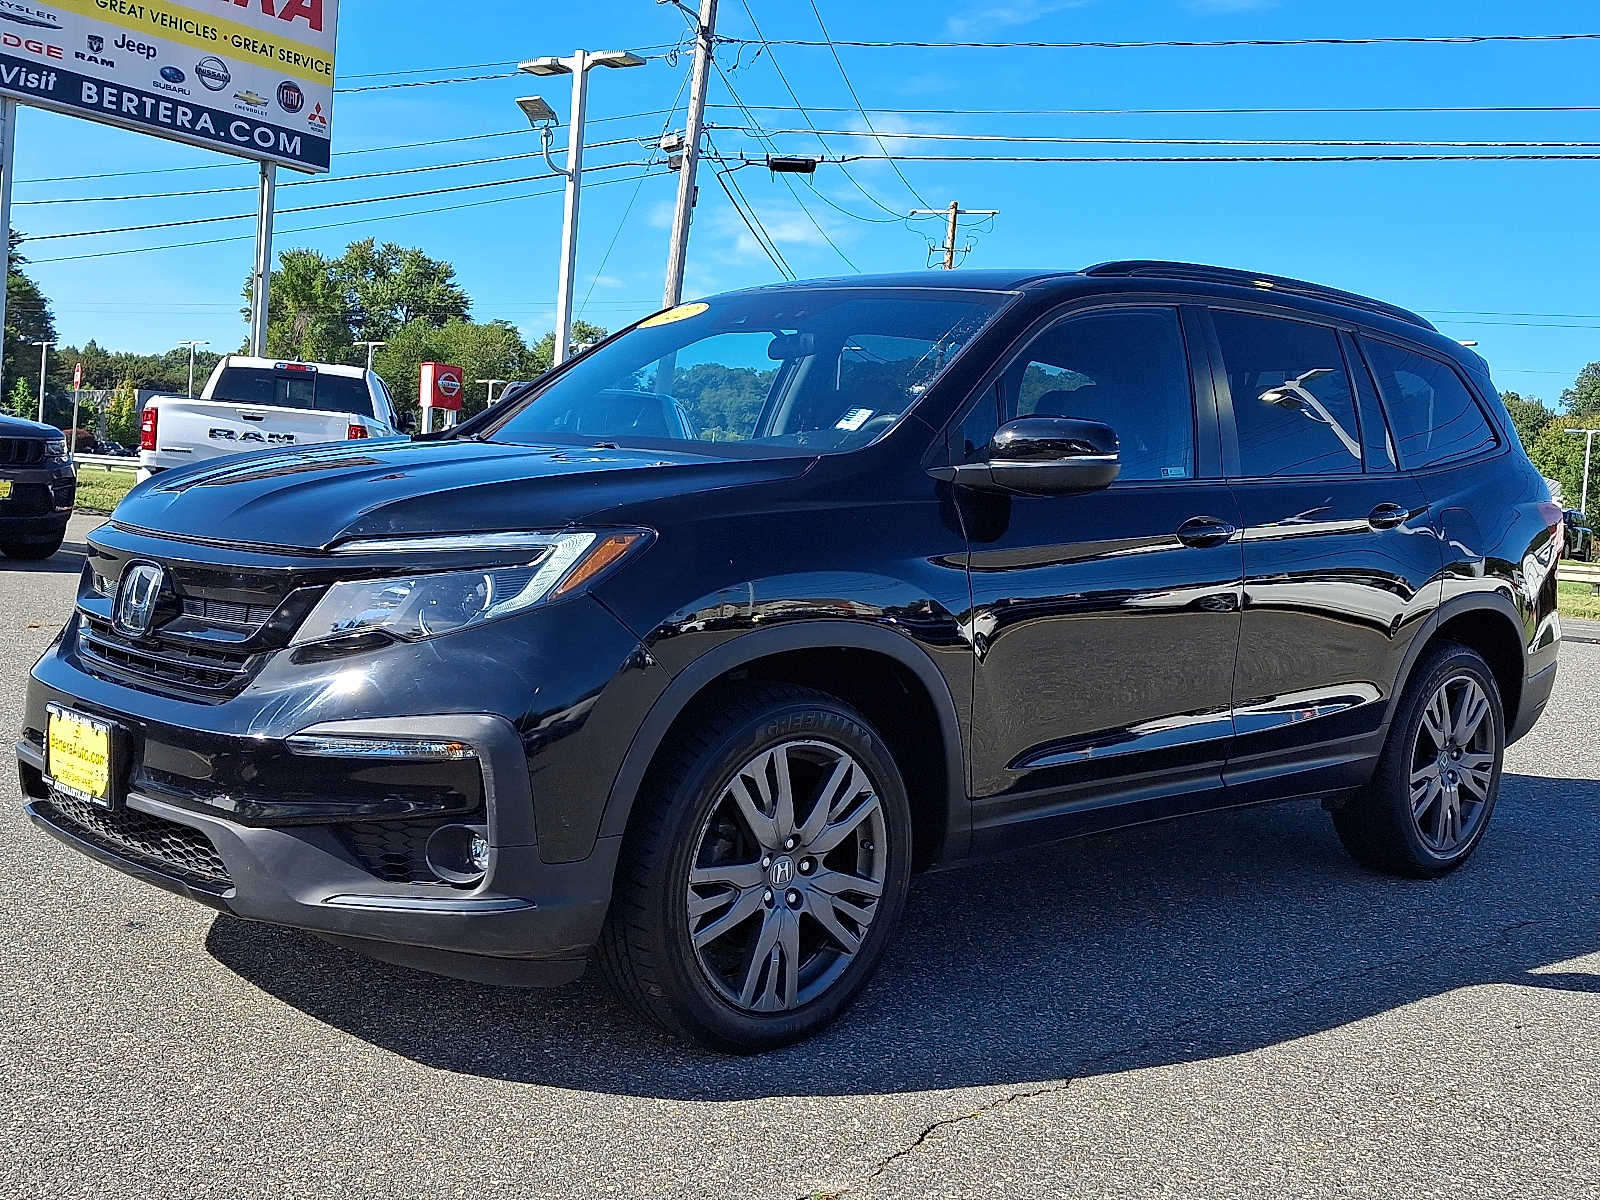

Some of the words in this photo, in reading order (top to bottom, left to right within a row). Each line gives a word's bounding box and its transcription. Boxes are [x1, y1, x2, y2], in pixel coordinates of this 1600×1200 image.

[96, 0, 145, 19] GREAT
[149, 9, 217, 41] VEHICLES
[231, 34, 275, 58] GREAT
[278, 48, 332, 76] SERVICE
[114, 33, 157, 60] Jeep
[74, 51, 115, 68] RAM
[198, 67, 229, 80] NISSAN
[152, 80, 191, 96] SUBARU
[283, 88, 300, 108] FIAT
[0, 63, 58, 91] Visit
[81, 81, 302, 157] BERTERA.COM
[208, 427, 297, 444] RAM
